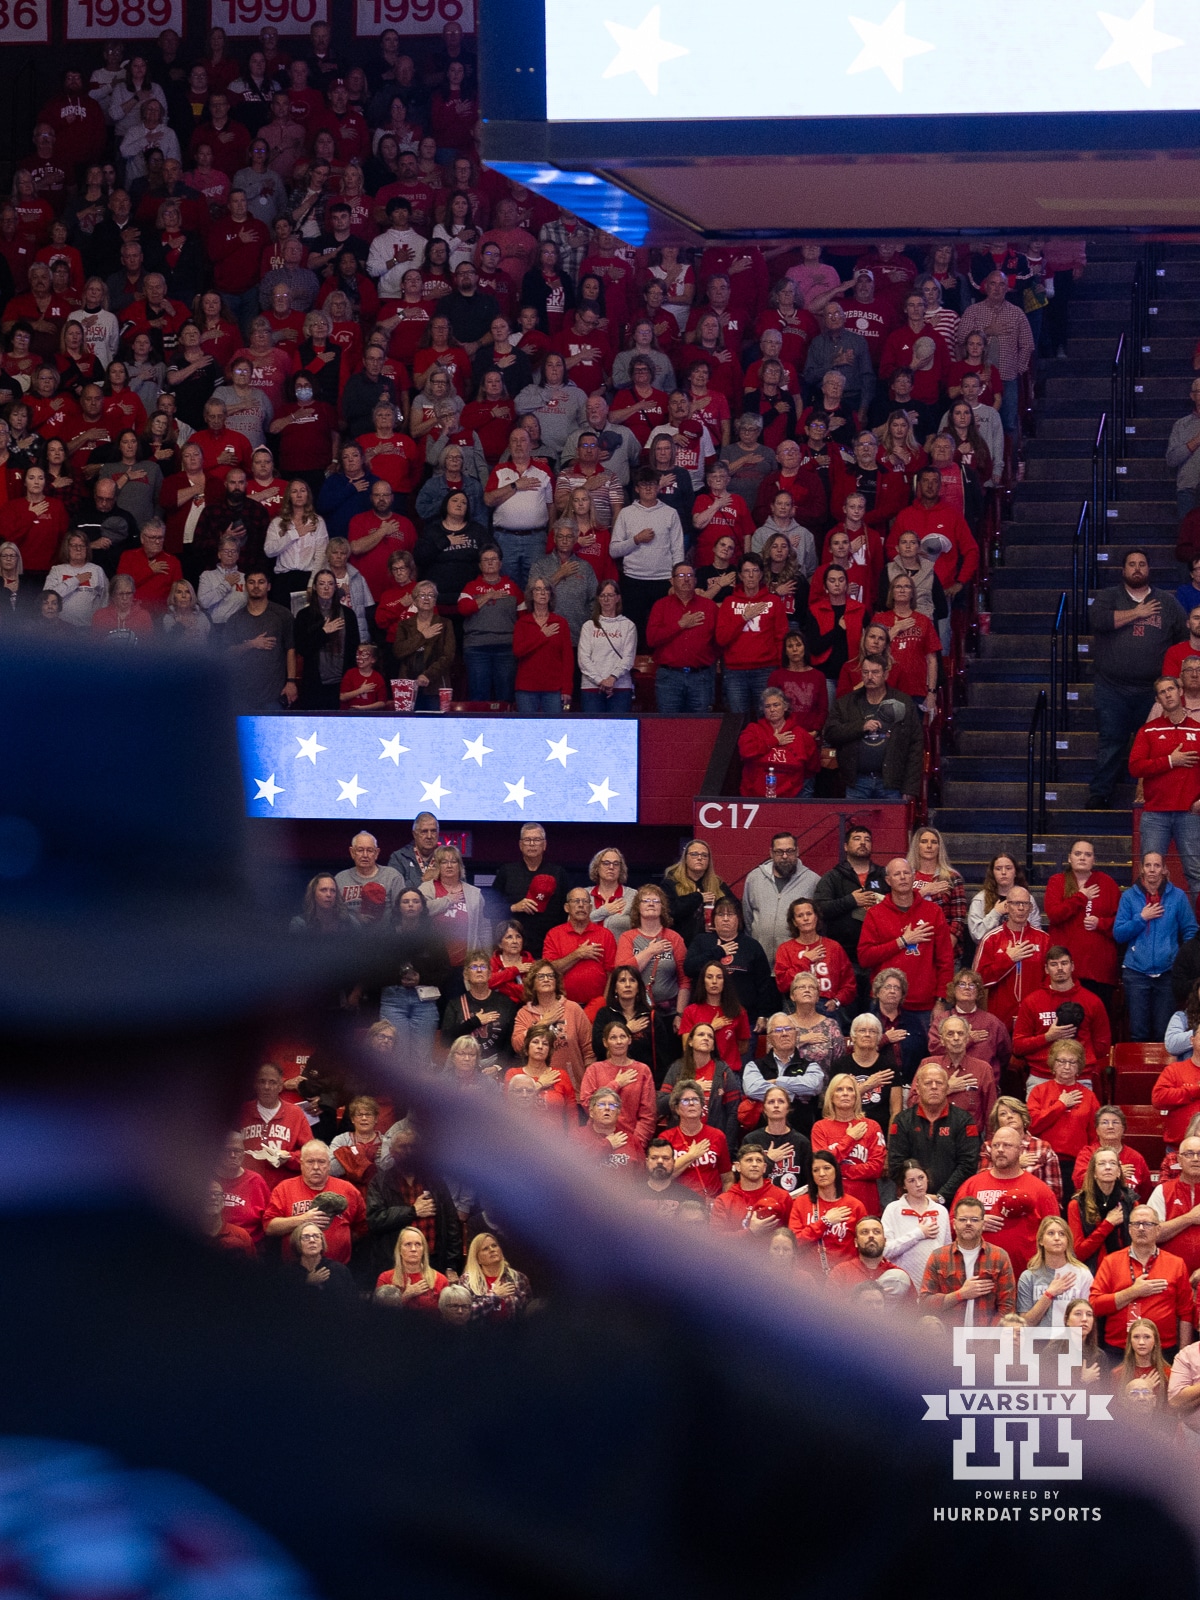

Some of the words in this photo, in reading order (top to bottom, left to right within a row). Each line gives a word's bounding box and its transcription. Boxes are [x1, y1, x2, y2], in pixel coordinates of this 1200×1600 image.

[80, 0, 172, 27] 1989
[227, 0, 316, 23] 1990
[372, 0, 465, 23] 1996
[351, 205, 369, 217] ASKA
[52, 307, 61, 316] N
[728, 320, 739, 331] N
[339, 335, 350, 343] N
[251, 368, 264, 379] N
[961, 454, 972, 464] N
[235, 583, 244, 593] N
[1132, 625, 1145, 637] N
[898, 641, 907, 650] N
[1186, 732, 1197, 741] N
[698, 802, 760, 829] C17
[870, 880, 880, 889] N
[444, 909, 458, 919] N
[939, 1126, 950, 1137] N
